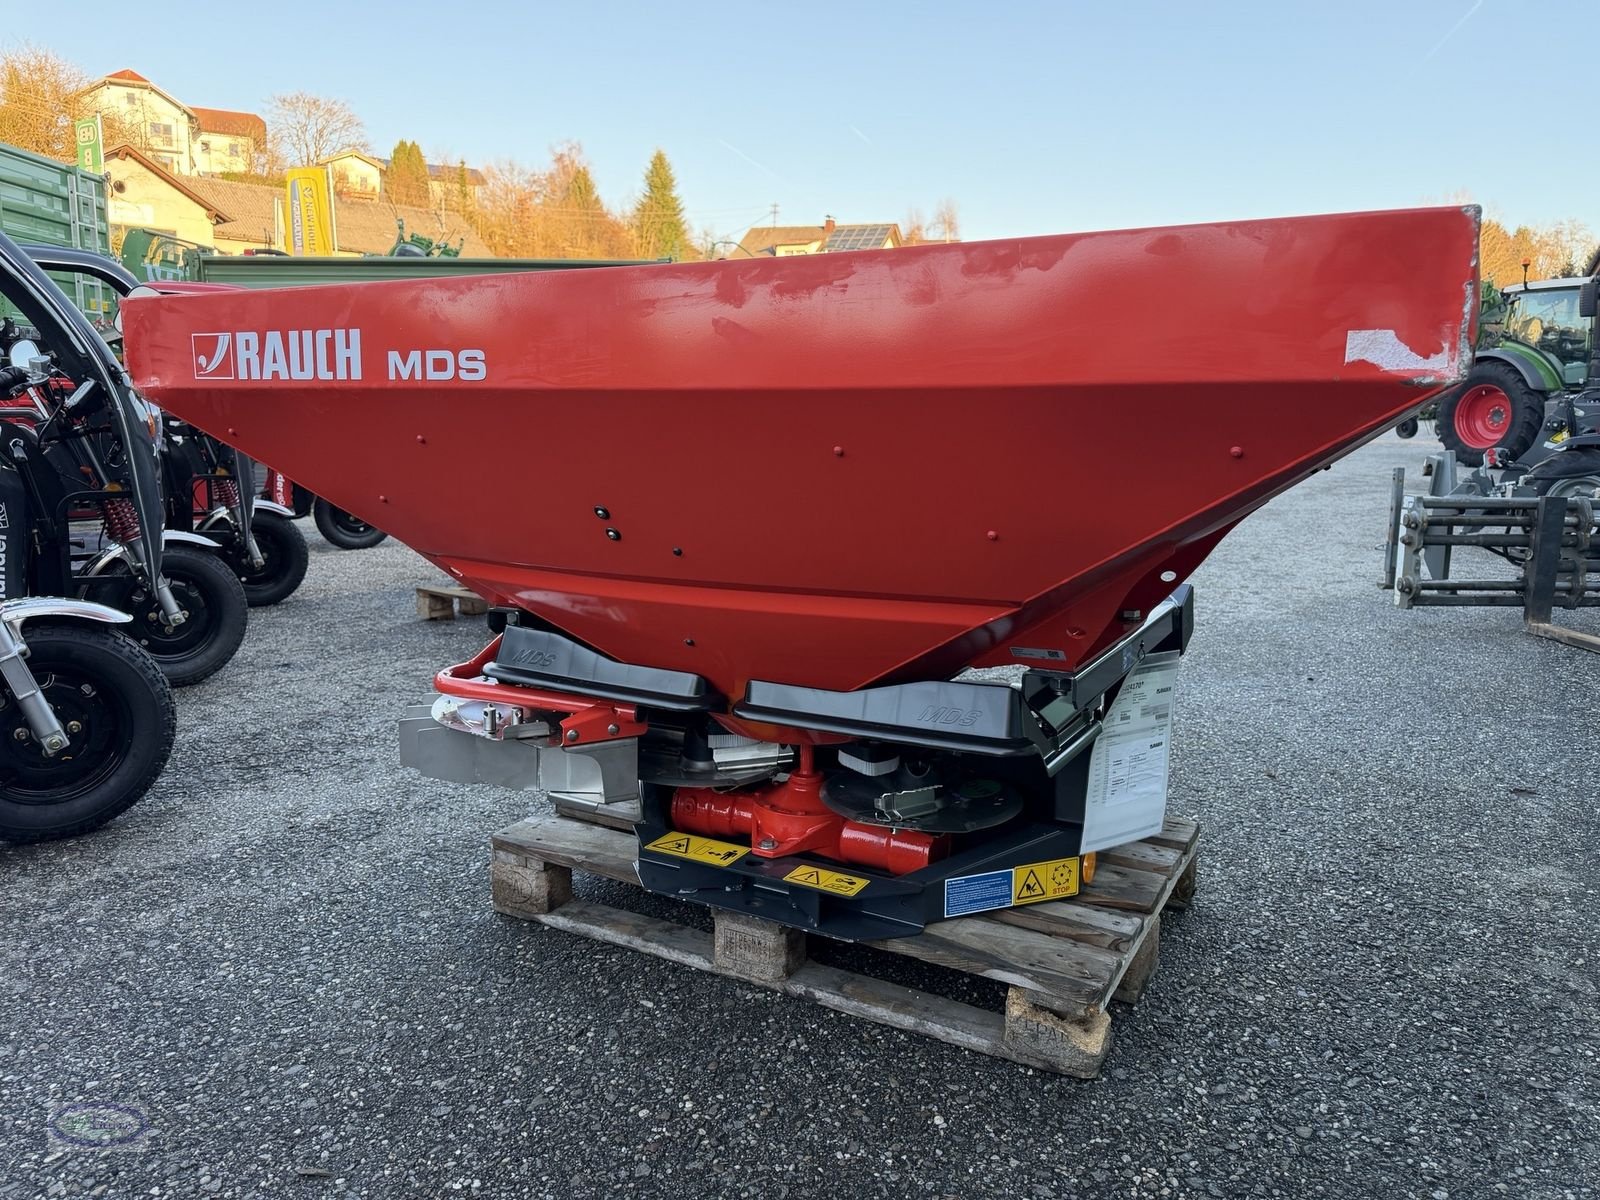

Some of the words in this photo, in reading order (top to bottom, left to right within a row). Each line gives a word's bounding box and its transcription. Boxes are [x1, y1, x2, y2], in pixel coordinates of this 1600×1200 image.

[305, 201, 315, 223] NEW
[307, 224, 317, 254] HOLLA
[235, 328, 362, 381] RAUCH
[388, 349, 487, 381] MDS
[511, 648, 557, 667] MDS
[916, 705, 983, 726] MDS
[1052, 885, 1070, 895] STOP
